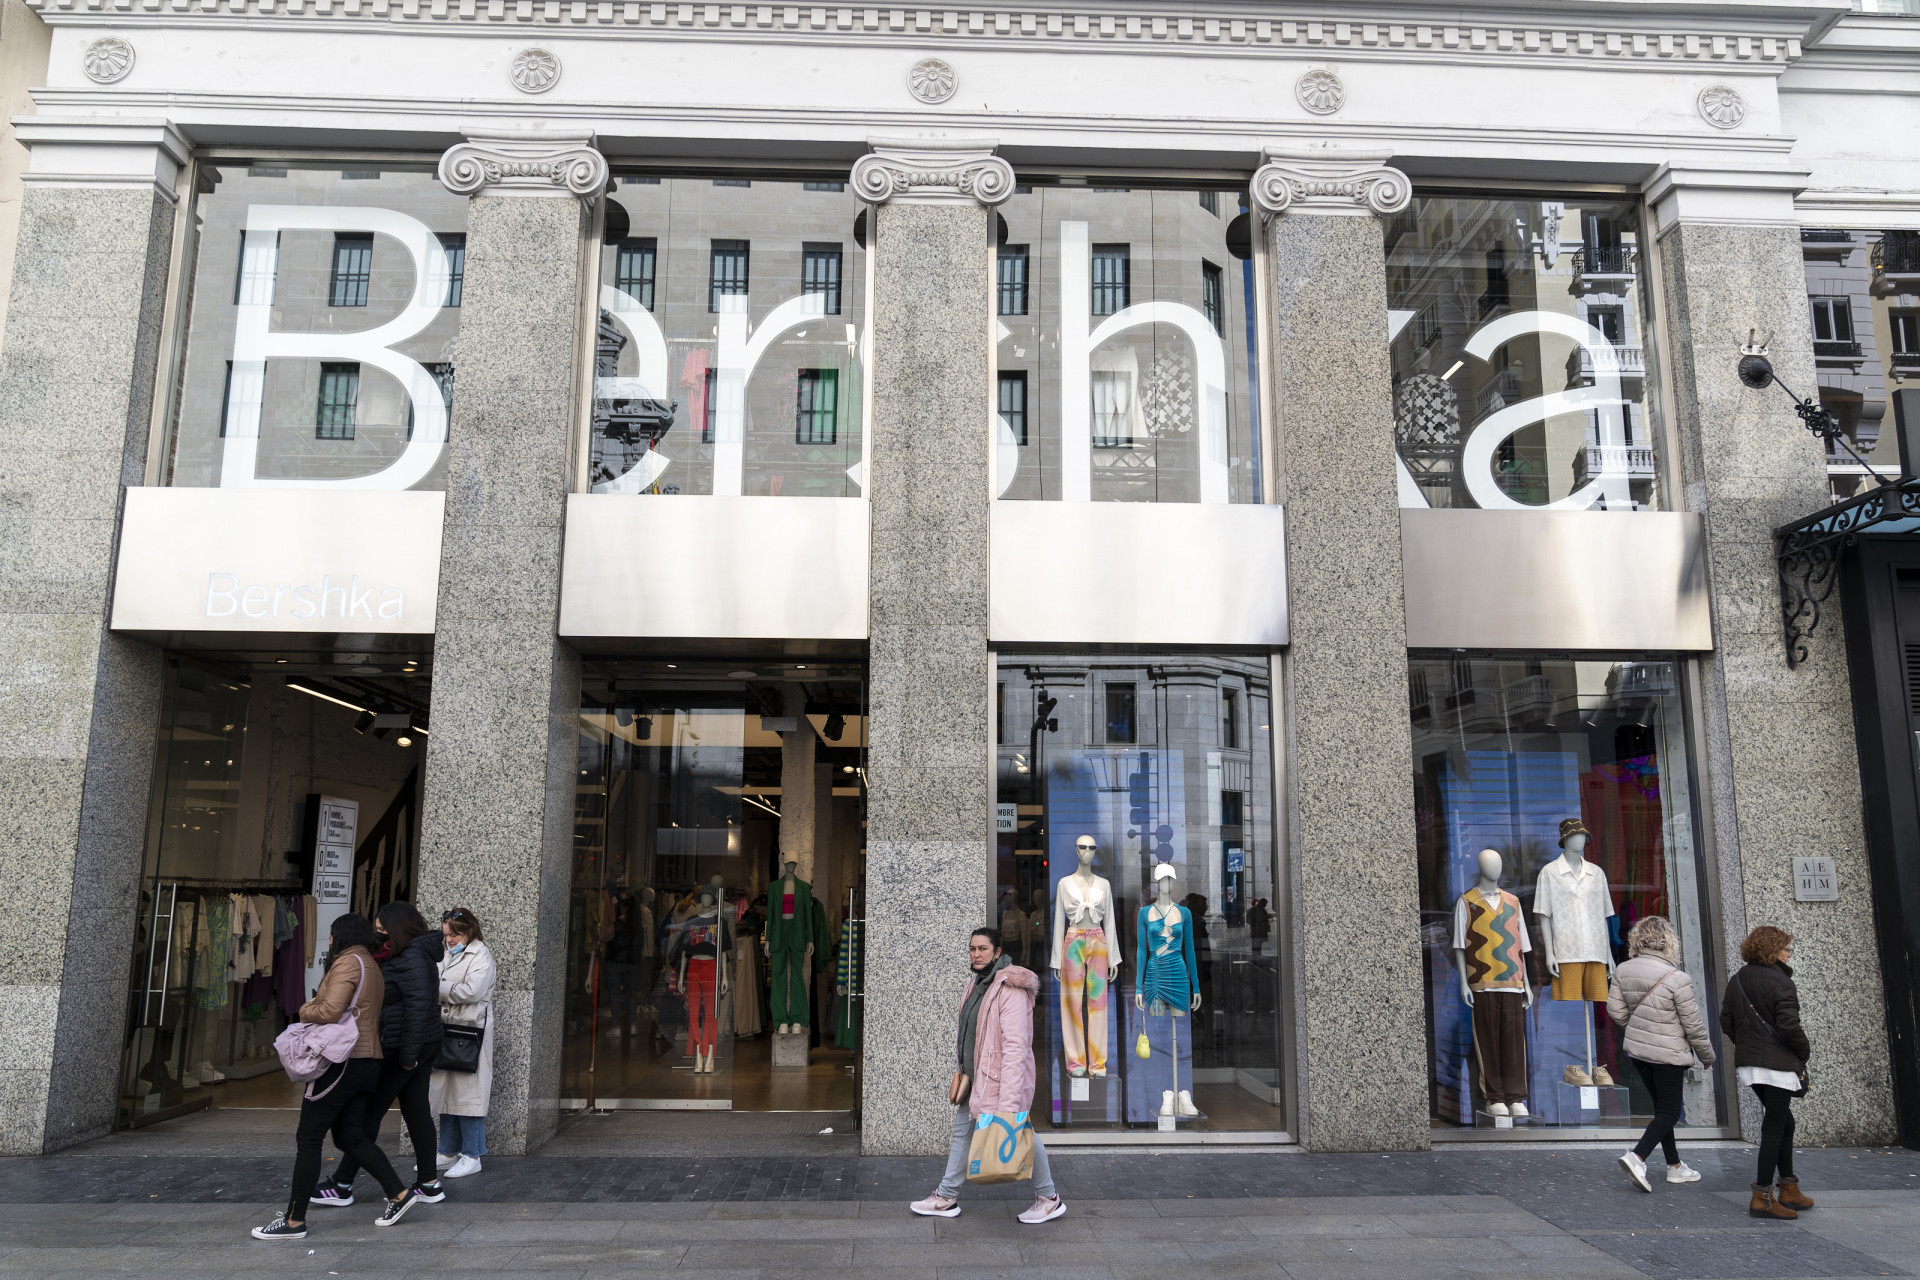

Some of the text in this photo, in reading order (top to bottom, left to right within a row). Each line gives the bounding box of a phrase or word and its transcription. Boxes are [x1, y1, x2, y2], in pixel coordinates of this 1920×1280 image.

[219, 204, 1632, 510] Brha
[205, 572, 405, 619] Bershka
[1802, 862, 1826, 872] A E
[1802, 879, 1829, 889] H M
